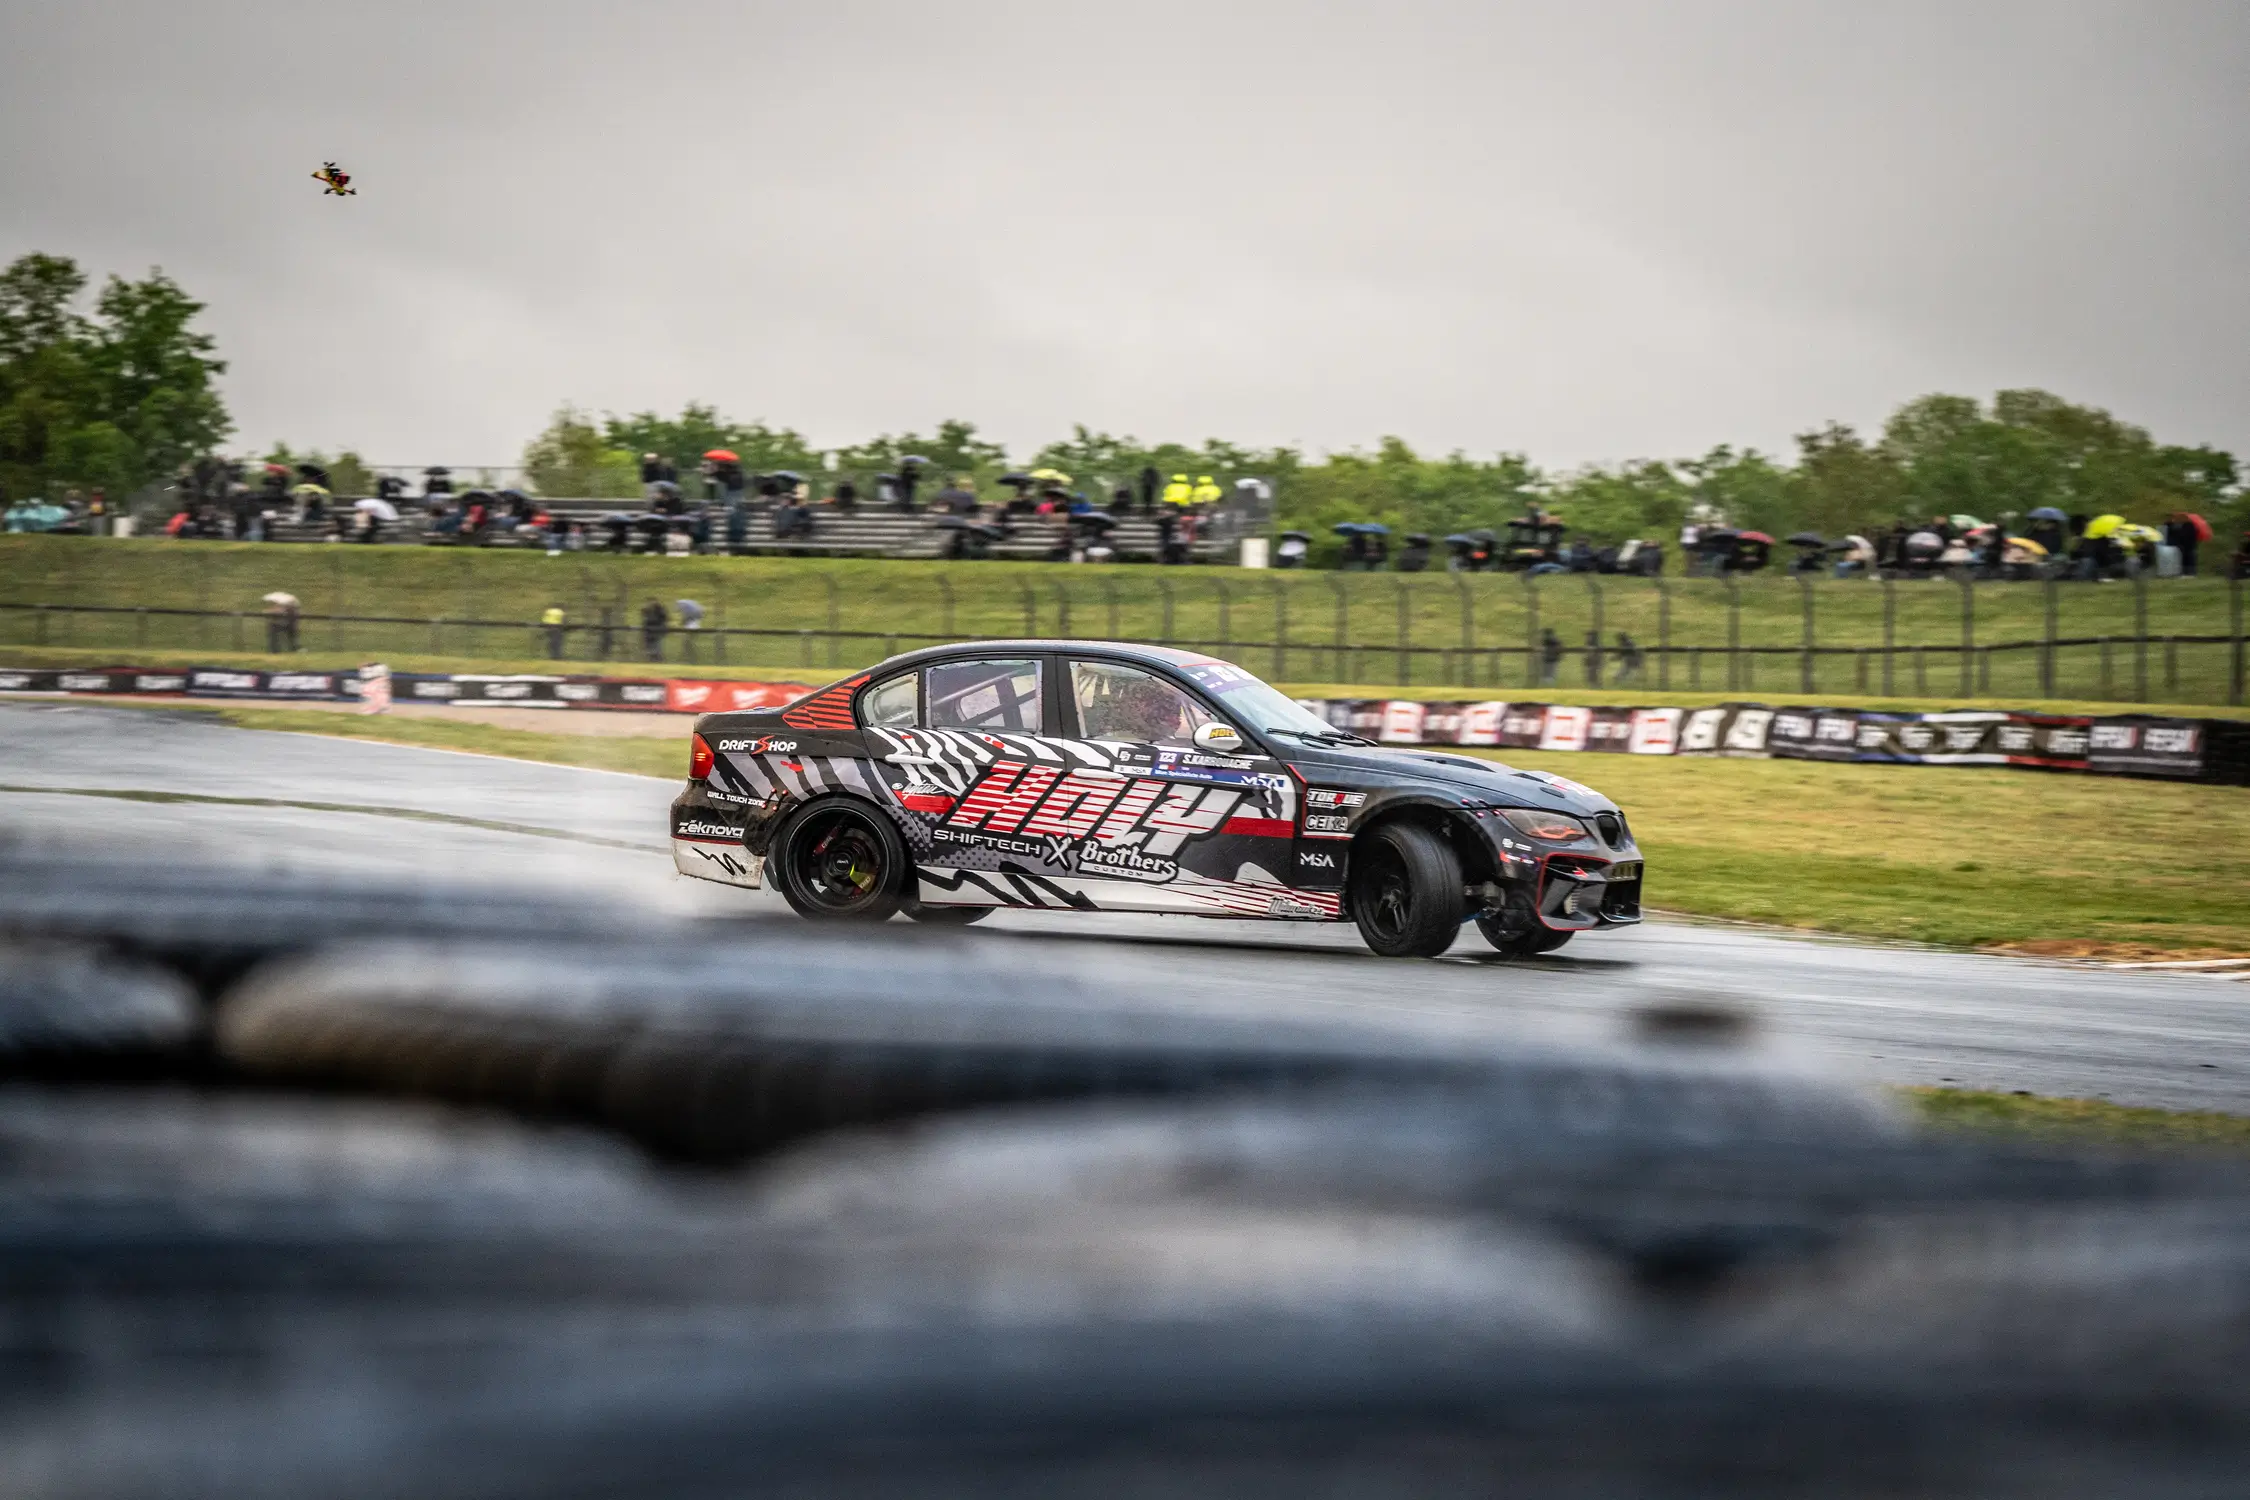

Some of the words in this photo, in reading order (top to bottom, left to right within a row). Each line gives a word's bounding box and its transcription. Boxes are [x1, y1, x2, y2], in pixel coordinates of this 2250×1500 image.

[719, 735, 798, 755] DRIFTSHOP
[1158, 752, 1178, 763] 123
[707, 791, 726, 800] WALL
[726, 794, 748, 803] TOUCH
[748, 796, 767, 806] ZONE
[1308, 791, 1364, 806] TORQUE
[933, 829, 1041, 855] SHIFTECH
[1079, 839, 1178, 874] Brothers
[1300, 852, 1335, 868] MSA
[1094, 865, 1144, 877] CUSTOM
